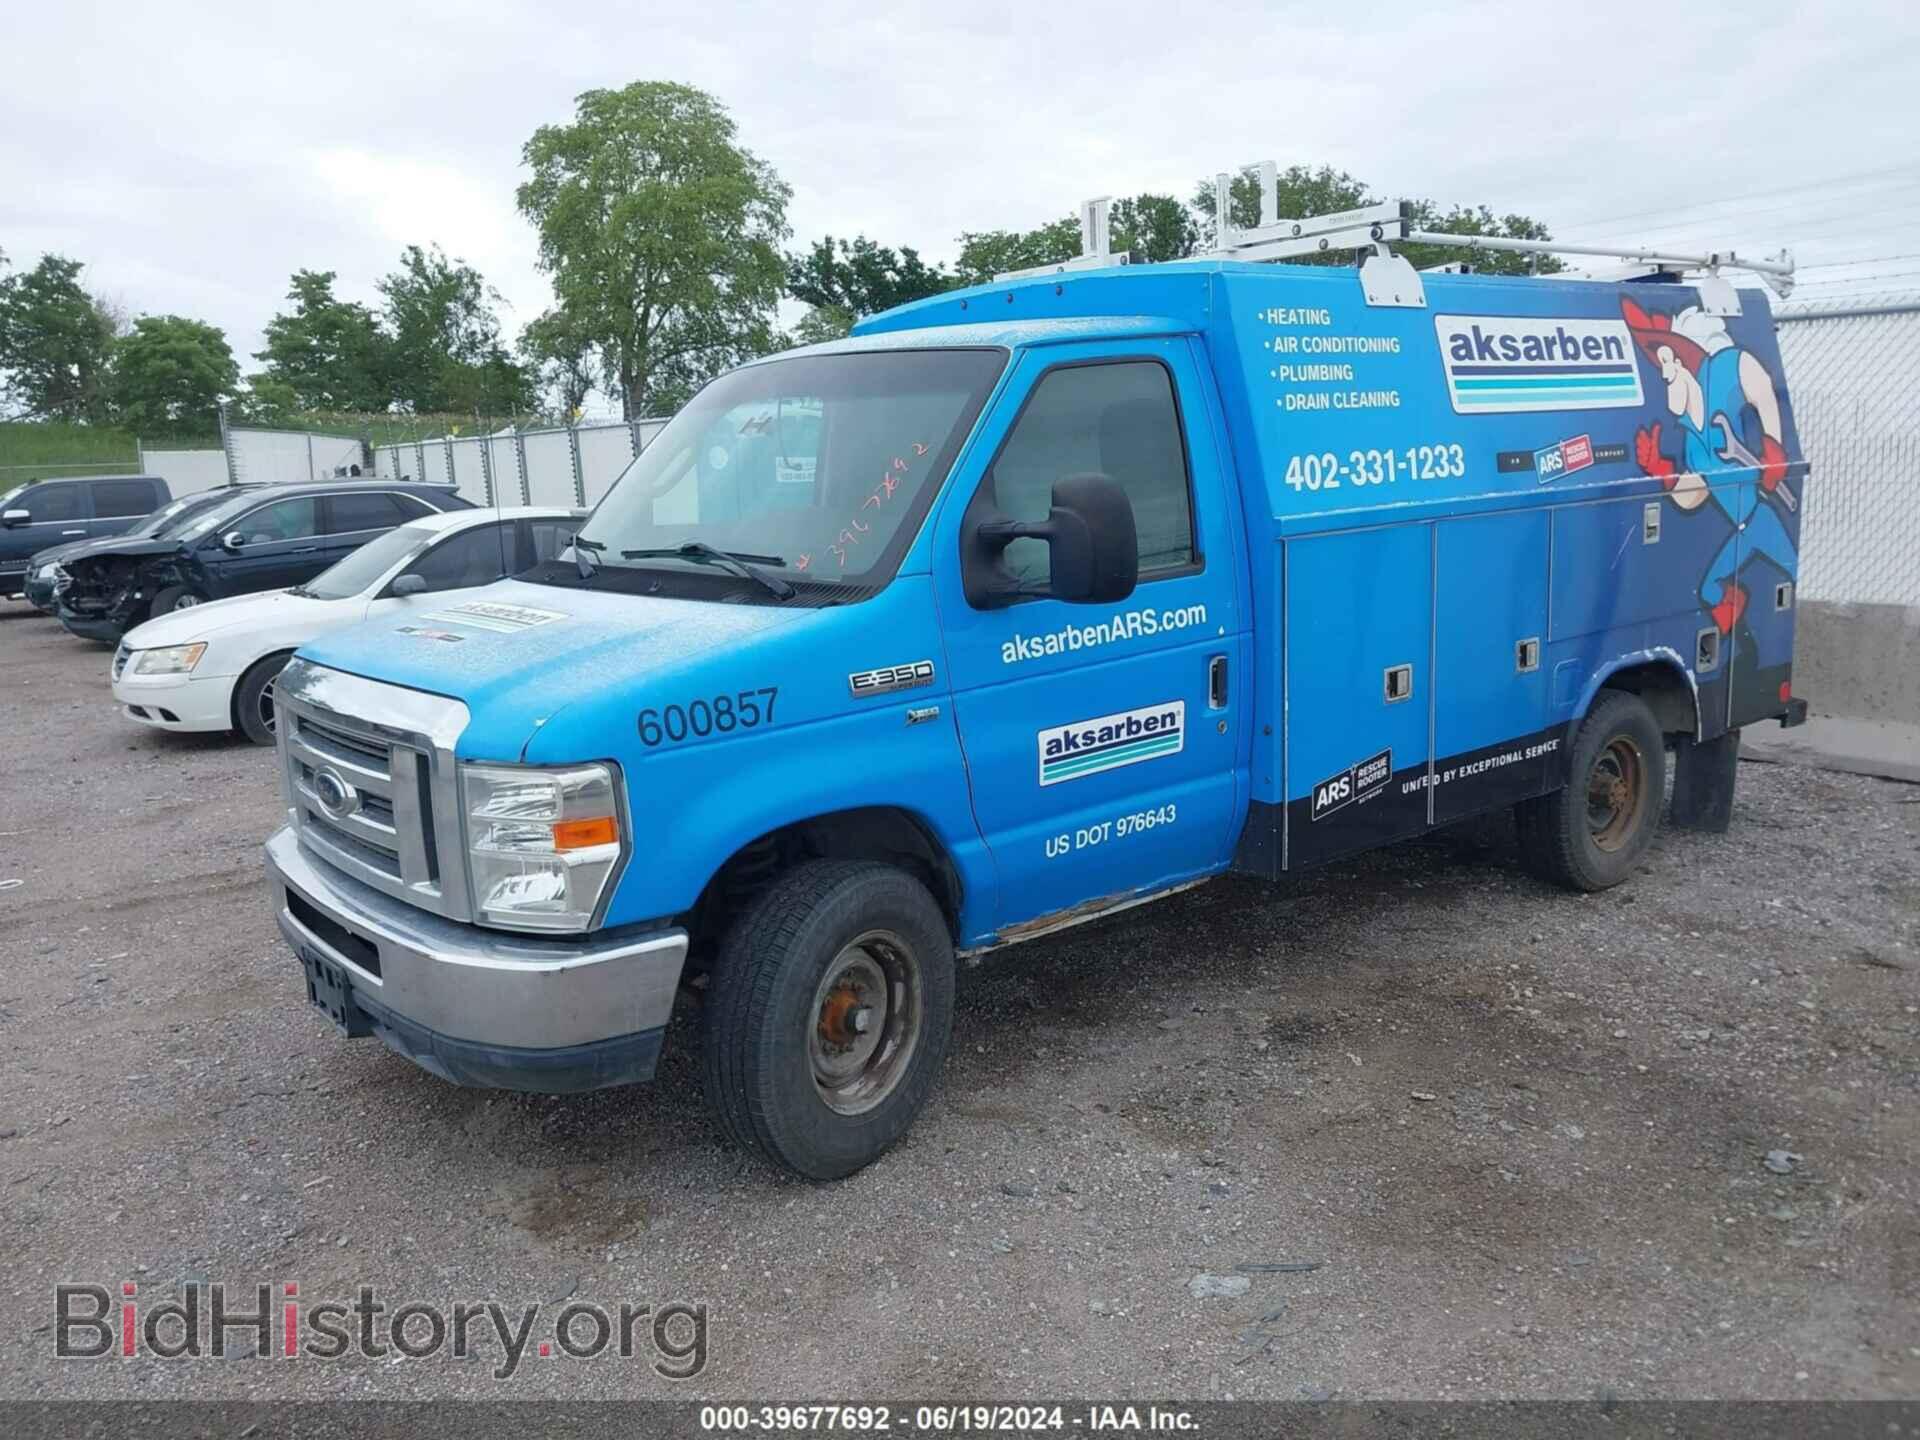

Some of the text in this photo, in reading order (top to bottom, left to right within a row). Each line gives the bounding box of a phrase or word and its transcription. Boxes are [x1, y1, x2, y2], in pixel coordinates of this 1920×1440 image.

[1266, 308, 1331, 325] HEATING
[1273, 336, 1400, 353] AIR CONDITIONING
[1450, 325, 1624, 361] aksarben
[1280, 364, 1353, 381] PLUMBING
[1285, 391, 1400, 411] DRAIN CLEANING
[1285, 443, 1465, 492] 402-331-1233
[1540, 451, 1564, 475] ARS
[1001, 604, 1206, 664] aksarbenARS.com
[852, 663, 933, 689] E-350
[637, 686, 779, 747] 600857
[1046, 710, 1176, 757] aksarben
[1357, 767, 1388, 789] ROOTER
[1358, 756, 1387, 778] RESCUE
[1444, 769, 1456, 783] BY
[1459, 752, 1523, 778] EXCEPTIONAL
[1315, 777, 1350, 810] ARS
[1045, 804, 1176, 858] US DOT 976643
